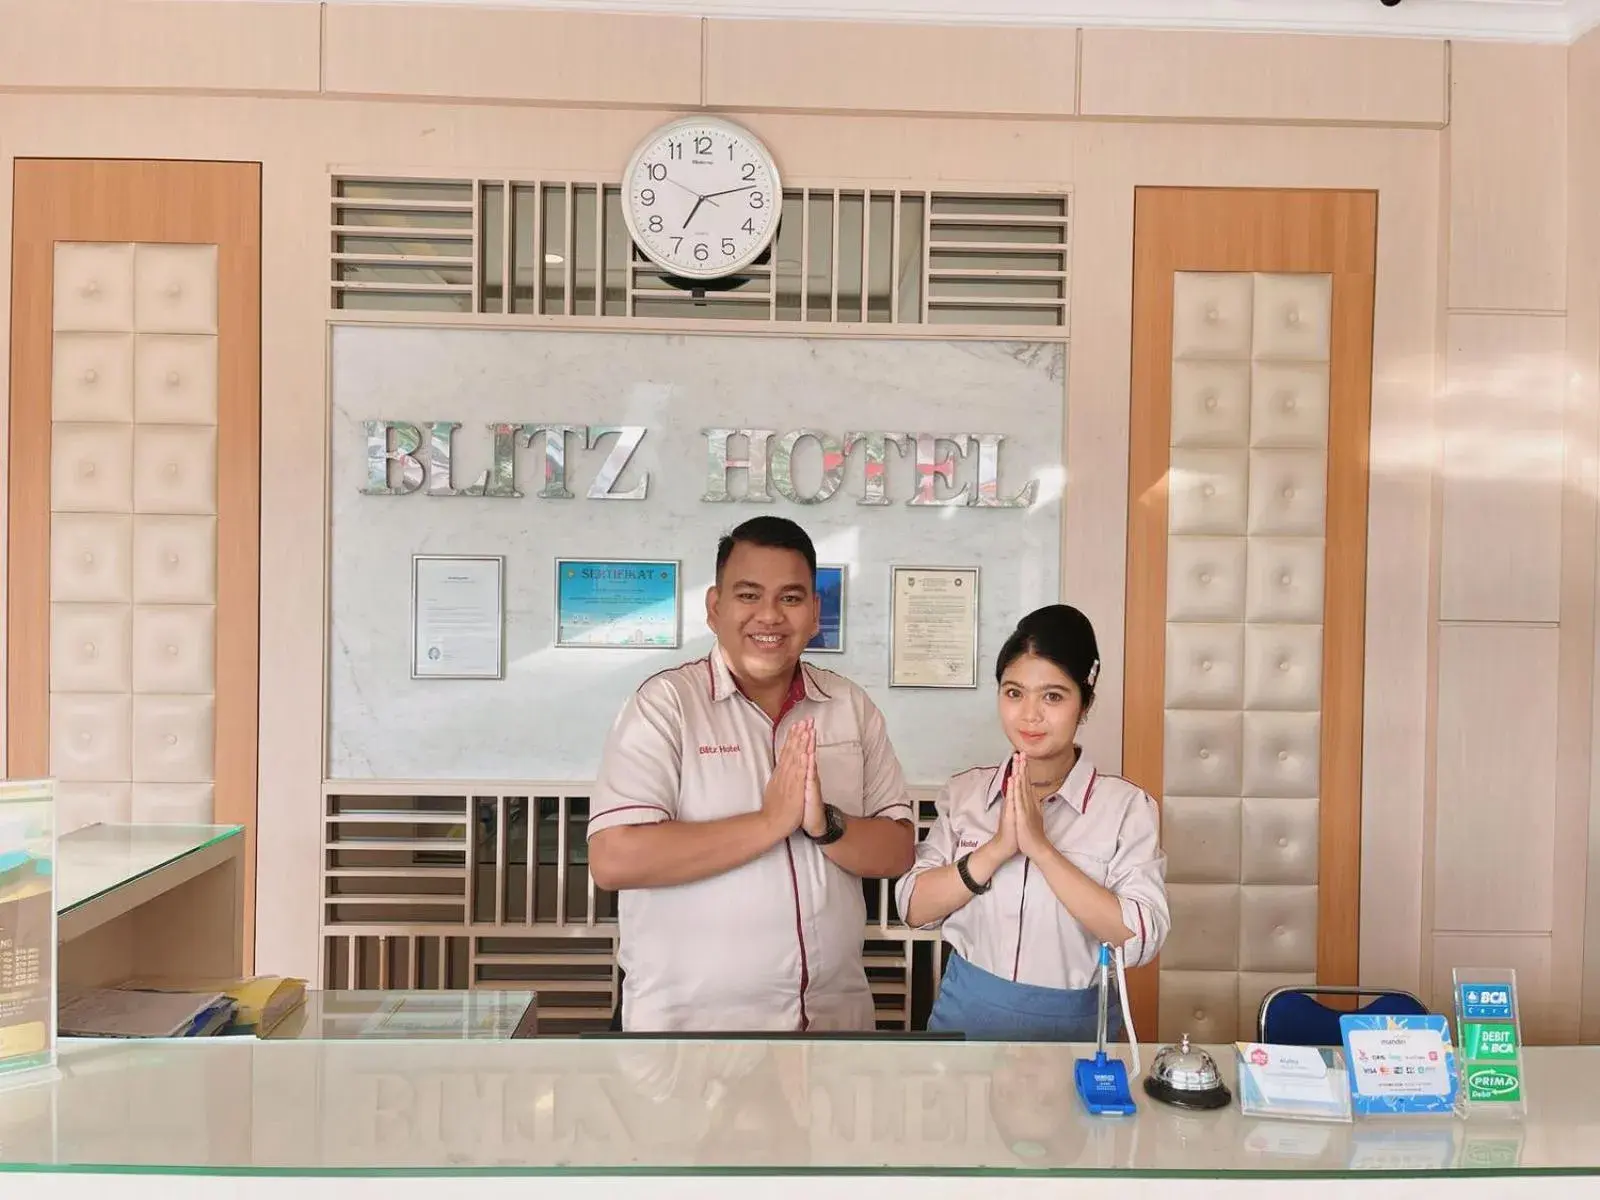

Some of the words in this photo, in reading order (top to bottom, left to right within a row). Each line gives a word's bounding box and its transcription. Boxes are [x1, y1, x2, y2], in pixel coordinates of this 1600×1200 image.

[669, 143, 682, 160] 11
[693, 137, 713, 155] 12
[728, 144, 734, 161] 1
[647, 163, 667, 181] 10
[741, 163, 756, 181] 2
[640, 189, 655, 206] 9
[749, 191, 764, 209] 3
[649, 215, 663, 233] 8
[741, 218, 755, 235] 4
[670, 236, 684, 254] 7
[694, 243, 709, 261] 6
[721, 238, 736, 256] 5
[358, 421, 650, 501] BLITZ
[699, 427, 1040, 508] HOTEL
[581, 568, 655, 580] SERTIFIKAT
[699, 745, 718, 755] Blitz
[719, 743, 741, 753] Hotel
[1480, 991, 1507, 1005] BCA
[1482, 1030, 1511, 1042] DEBIT
[1491, 1043, 1515, 1054] BCA
[1474, 1076, 1514, 1086] PRIMA
